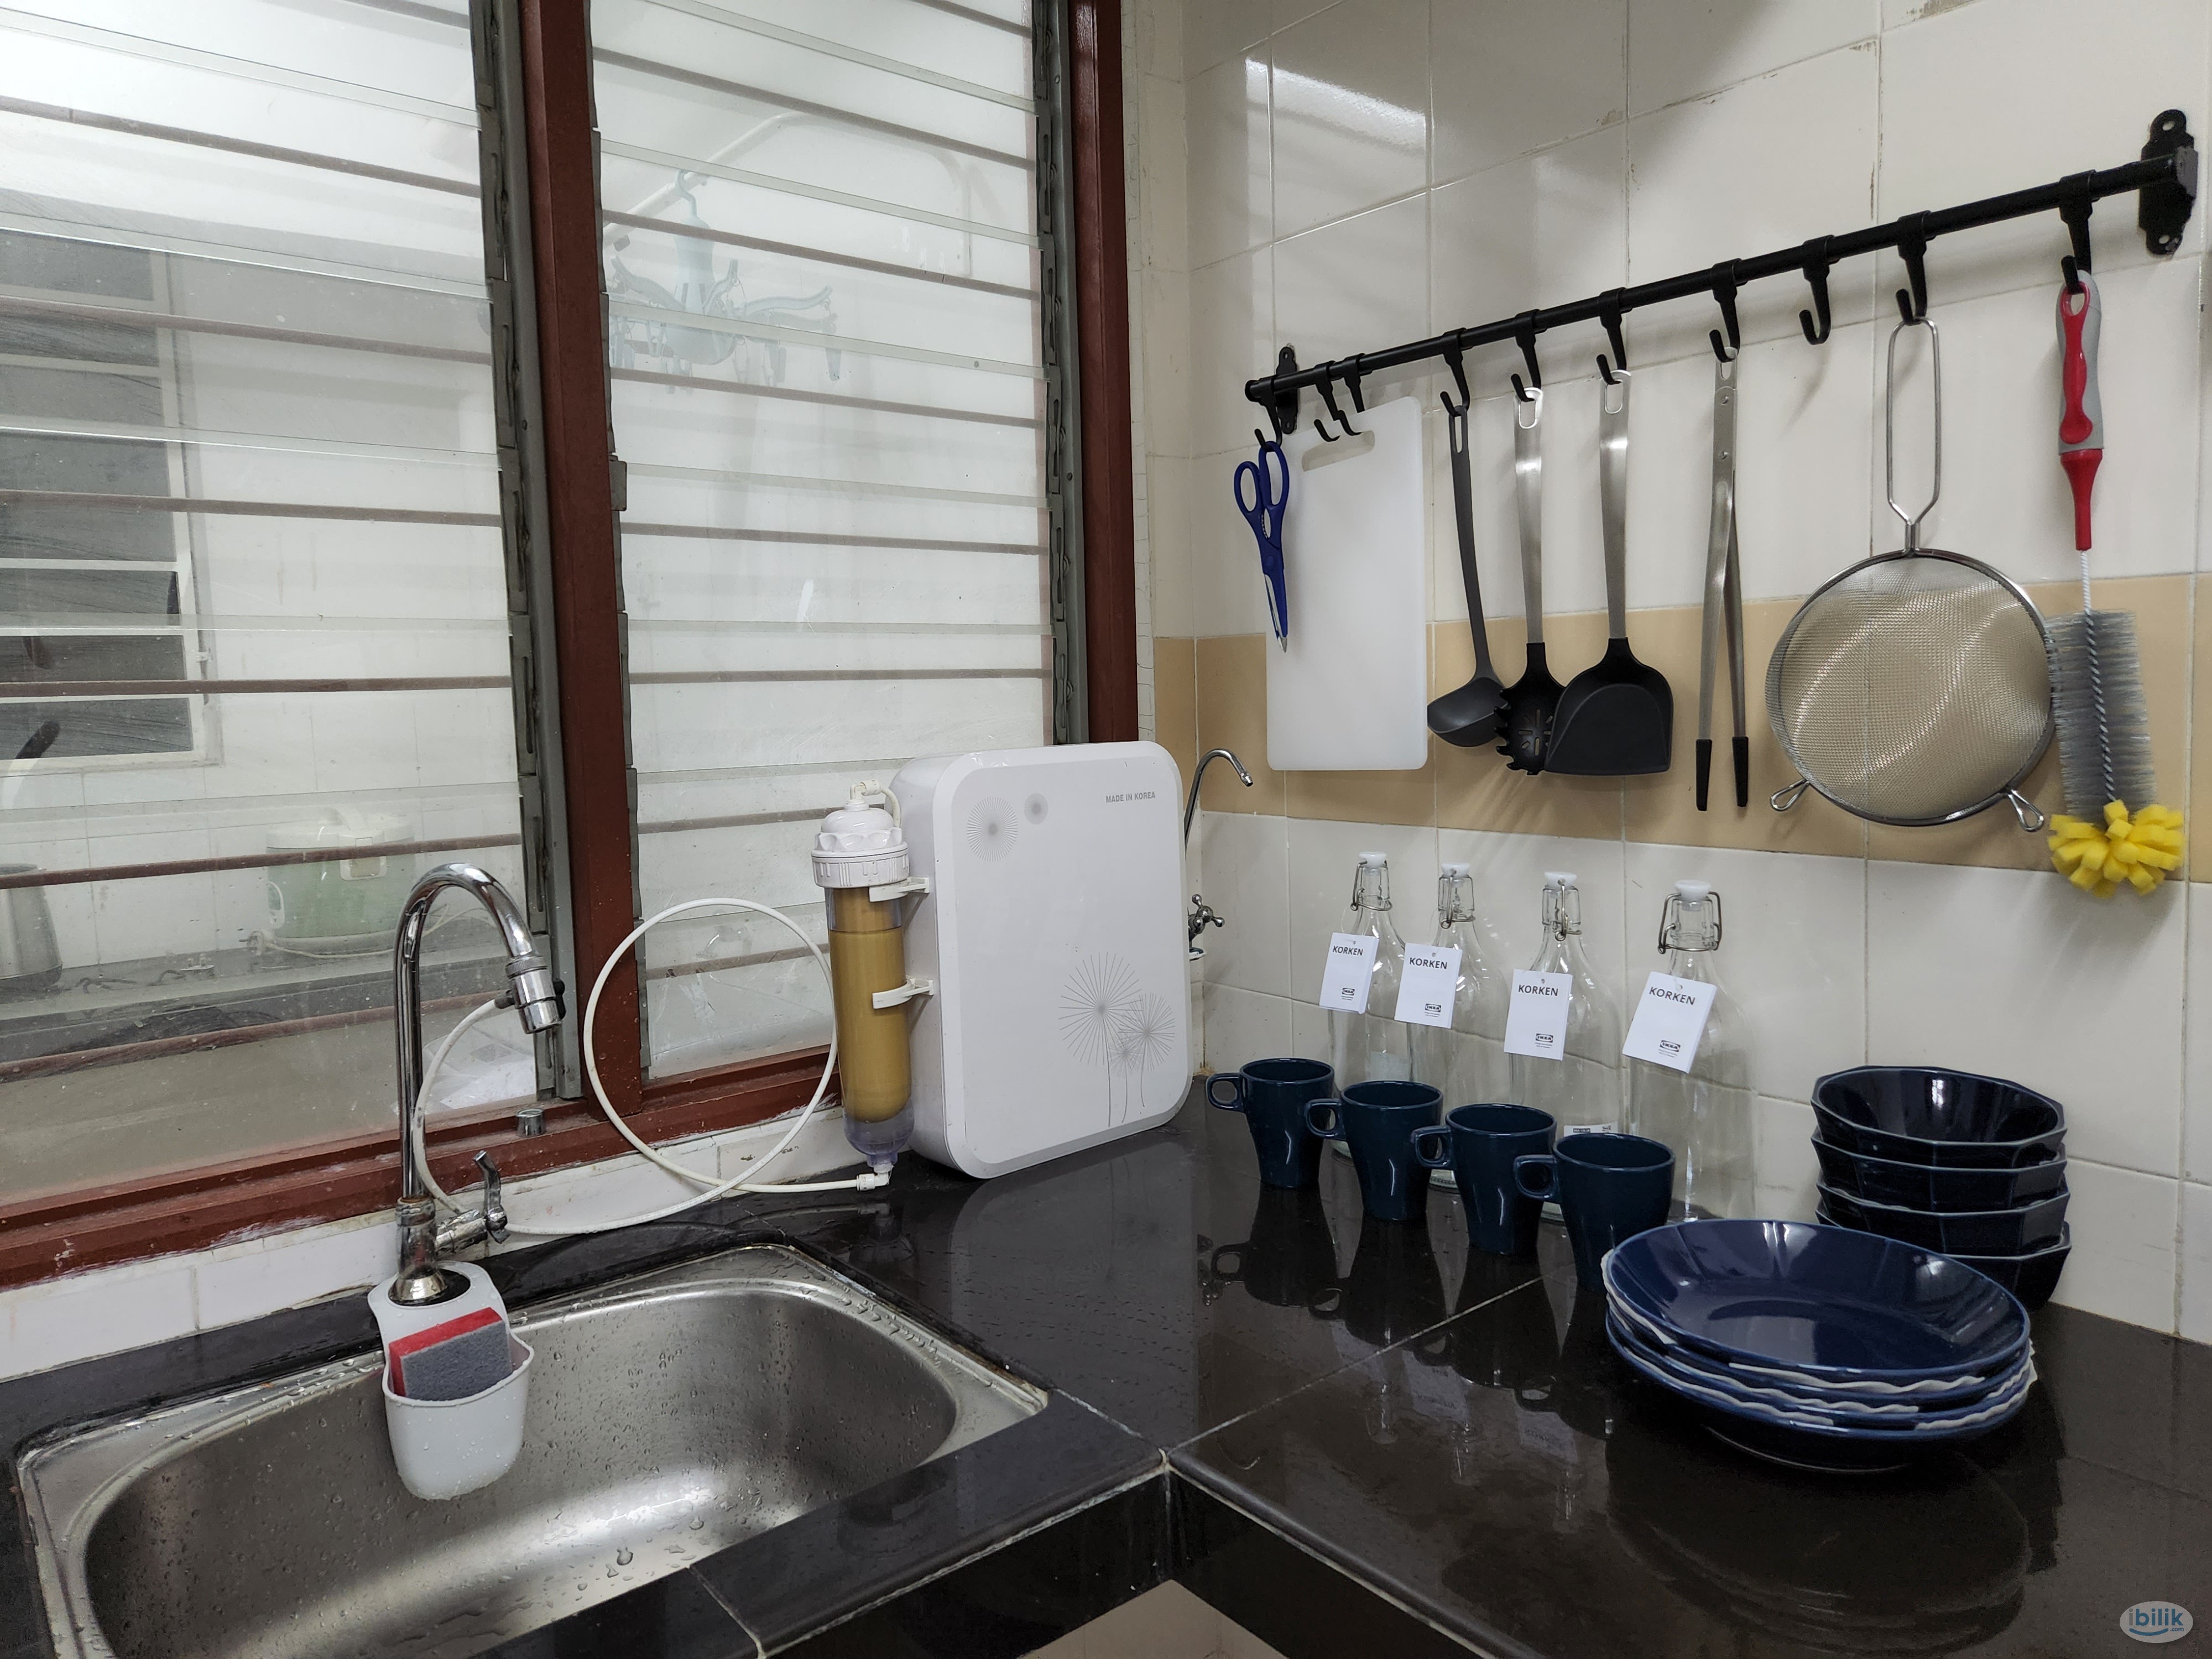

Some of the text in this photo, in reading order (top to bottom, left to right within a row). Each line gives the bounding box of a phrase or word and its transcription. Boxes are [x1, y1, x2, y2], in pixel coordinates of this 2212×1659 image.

[1105, 791, 1156, 803] MADE IN KOREA
[1332, 945, 1364, 956] KORKEN
[1409, 957, 1448, 969] KORKEN
[1518, 984, 1558, 997] KORKEN
[1648, 986, 1696, 1005] KORKEN
[1661, 1041, 1679, 1051] IKEA
